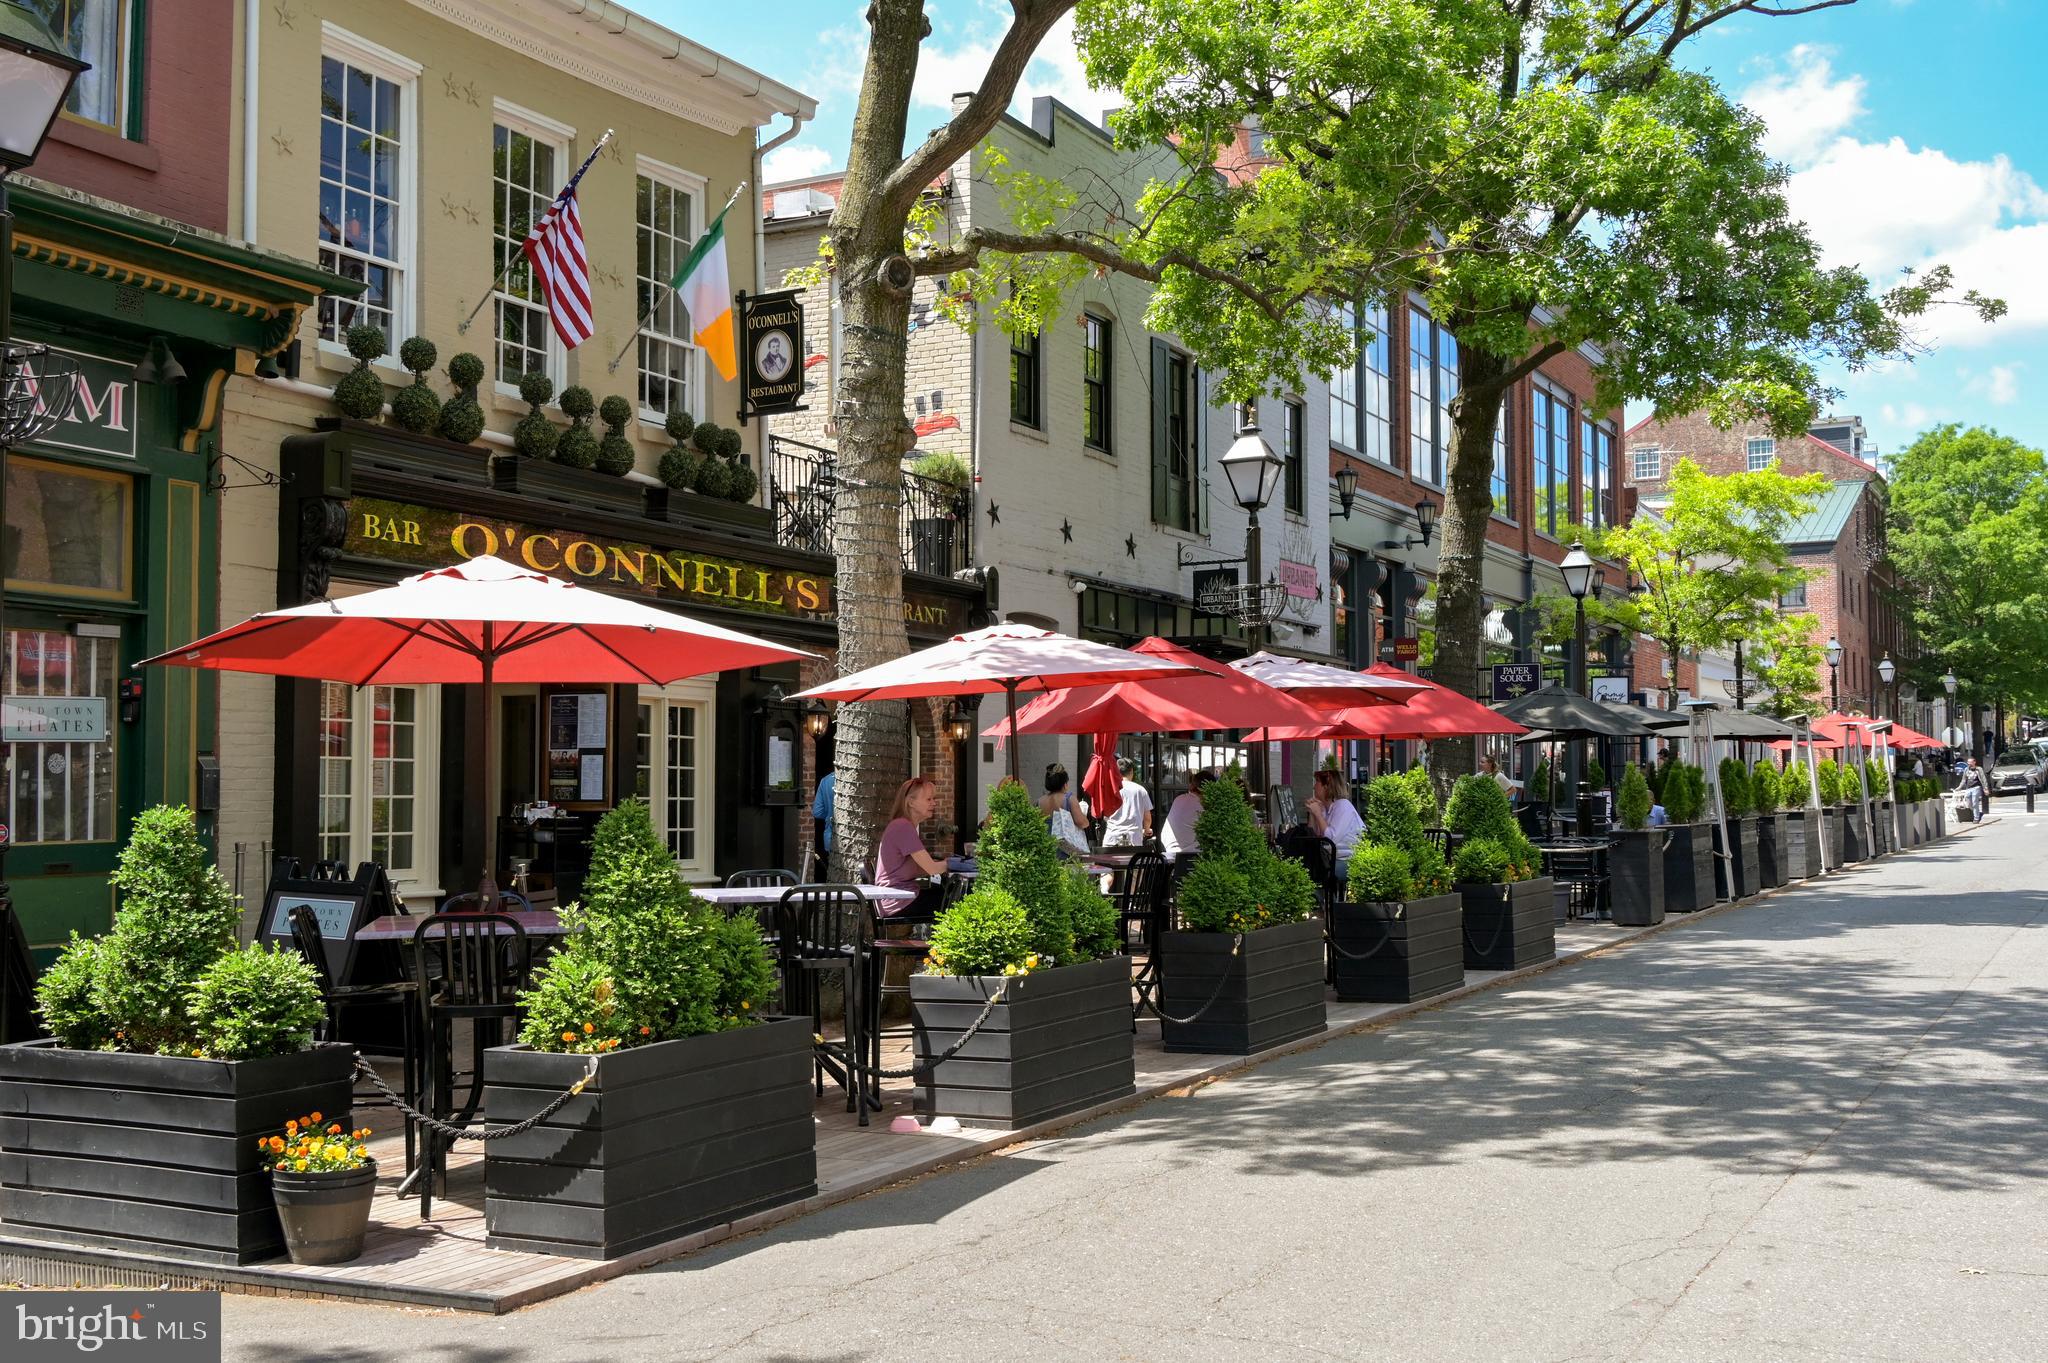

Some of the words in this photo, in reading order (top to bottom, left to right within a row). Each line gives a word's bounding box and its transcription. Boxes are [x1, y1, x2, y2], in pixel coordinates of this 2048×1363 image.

[749, 311, 798, 329] O'CONNELL'S
[751, 384, 798, 397] RESTAURANT
[362, 513, 423, 546] BAR
[450, 523, 820, 610] O'CONNELL'S
[55, 707, 93, 715] TOWN
[17, 720, 93, 732] PILATES
